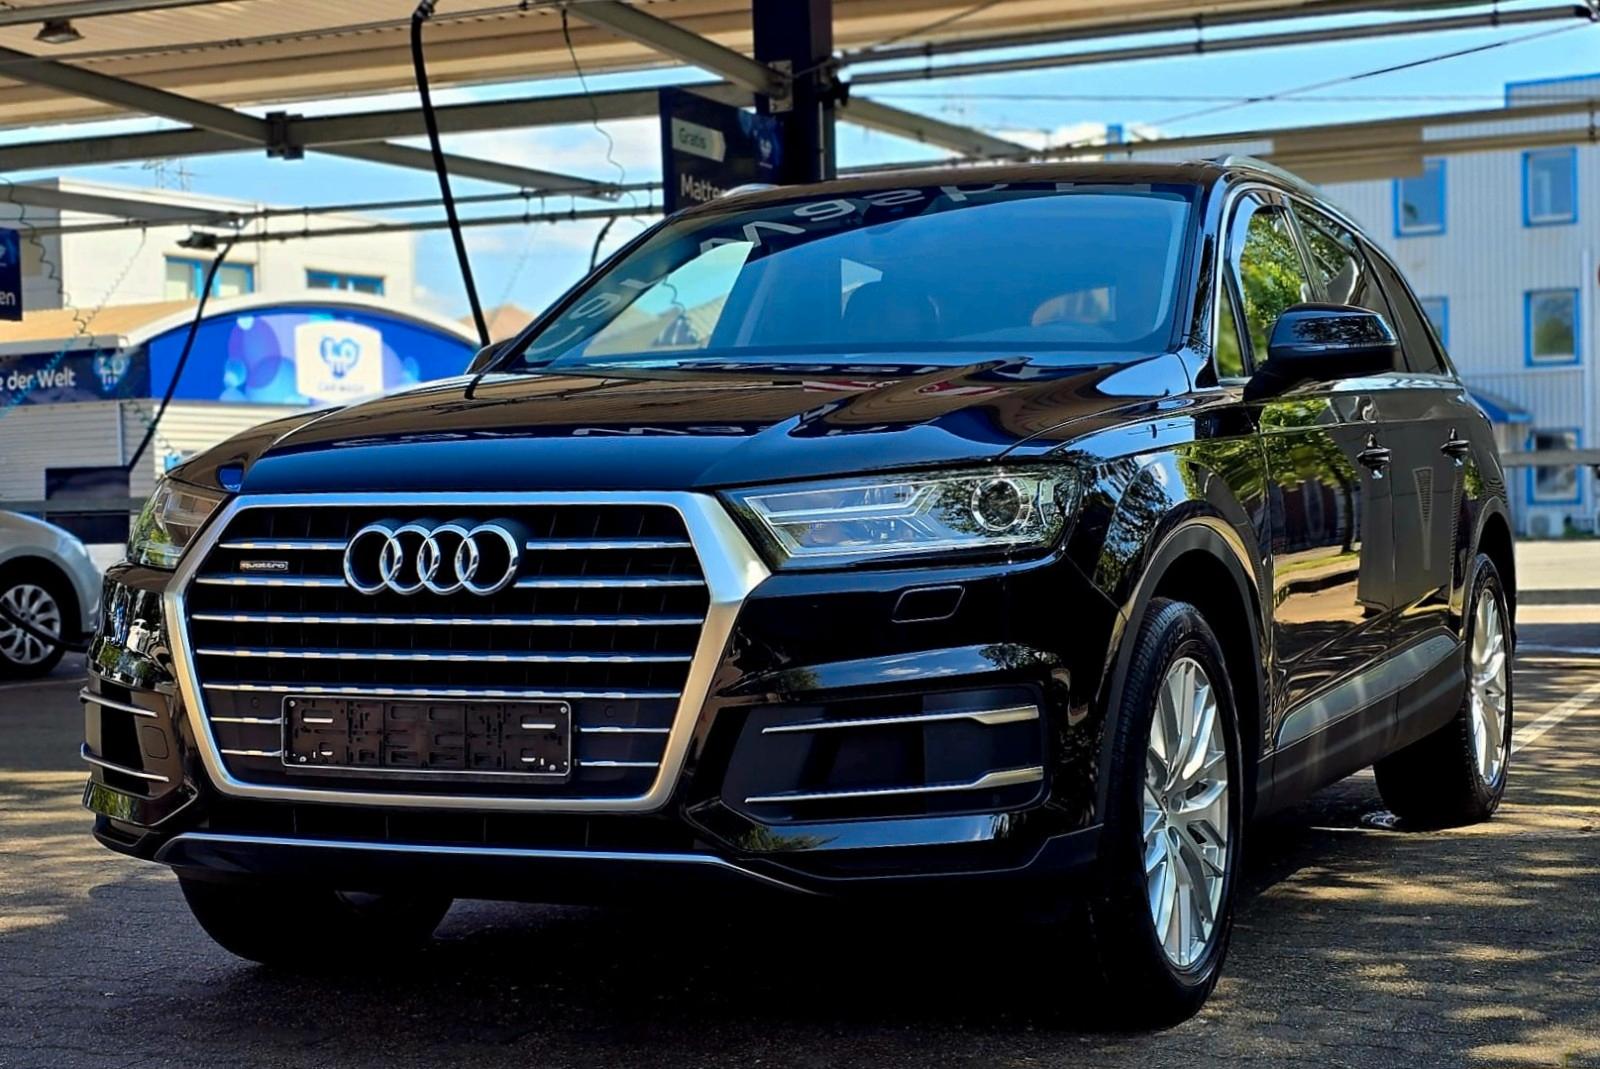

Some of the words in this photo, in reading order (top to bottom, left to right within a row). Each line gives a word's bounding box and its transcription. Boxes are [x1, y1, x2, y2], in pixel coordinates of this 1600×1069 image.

[679, 127, 706, 149] Gratis
[7, 371, 33, 390] der
[37, 367, 76, 388] Welt
[240, 562, 286, 570] quattro
